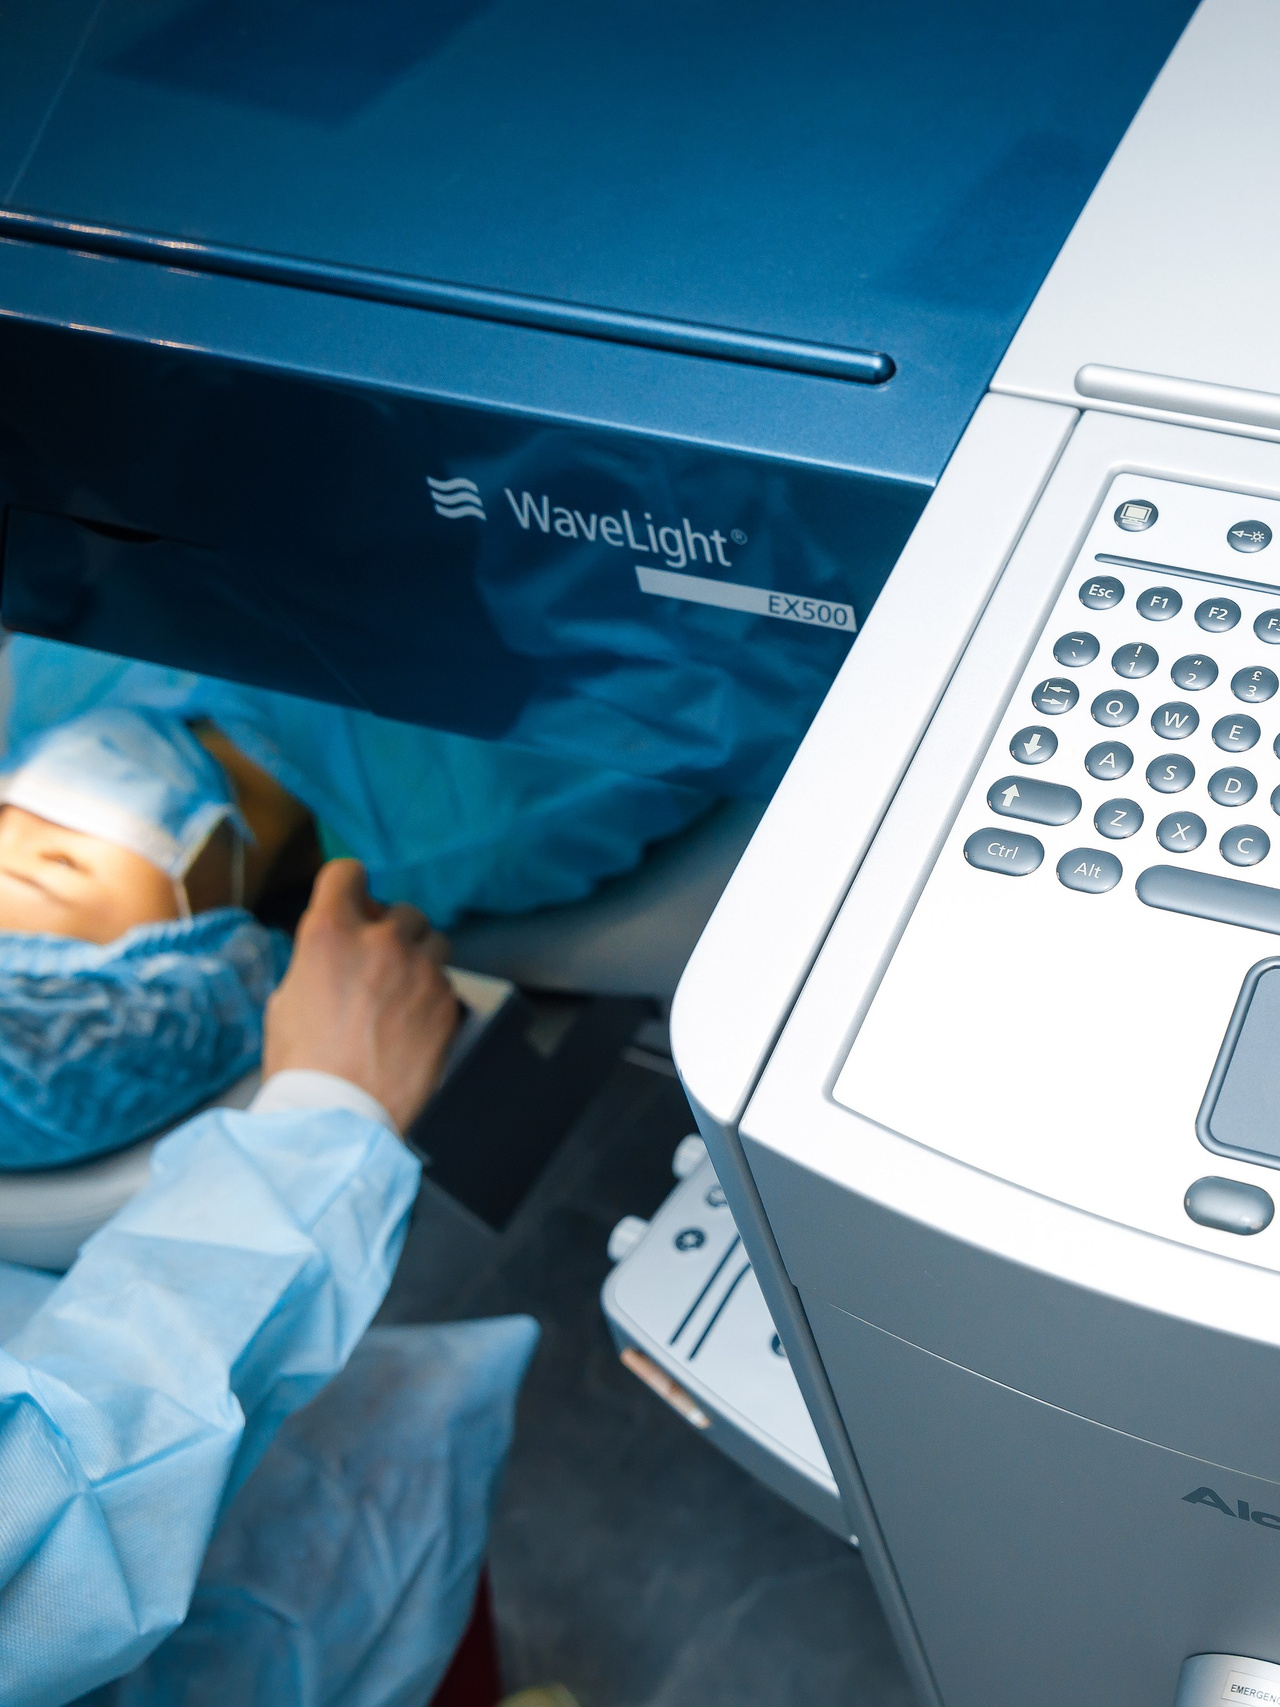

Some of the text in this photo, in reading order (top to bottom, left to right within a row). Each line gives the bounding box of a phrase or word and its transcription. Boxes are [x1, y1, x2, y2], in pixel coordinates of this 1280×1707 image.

[1089, 584, 1113, 598] Esc
[1151, 596, 1168, 608] F1
[768, 594, 848, 627] EX500
[1209, 607, 1228, 620] F2
[1135, 646, 1142, 657] !
[1129, 661, 1136, 673] 1
[1185, 673, 1197, 685] 2
[1252, 671, 1262, 681] £
[1245, 685, 1257, 697] 3
[1106, 700, 1123, 718] Q
[1165, 711, 1189, 728] W
[1229, 725, 1243, 740] E
[1099, 752, 1114, 767] A
[1164, 766, 1177, 780] S
[1225, 778, 1241, 793] D
[1111, 810, 1127, 826] Z
[1171, 823, 1191, 840] X
[988, 843, 1018, 859] Ctrl
[1238, 838, 1253, 853] C
[1074, 863, 1101, 878] Alt
